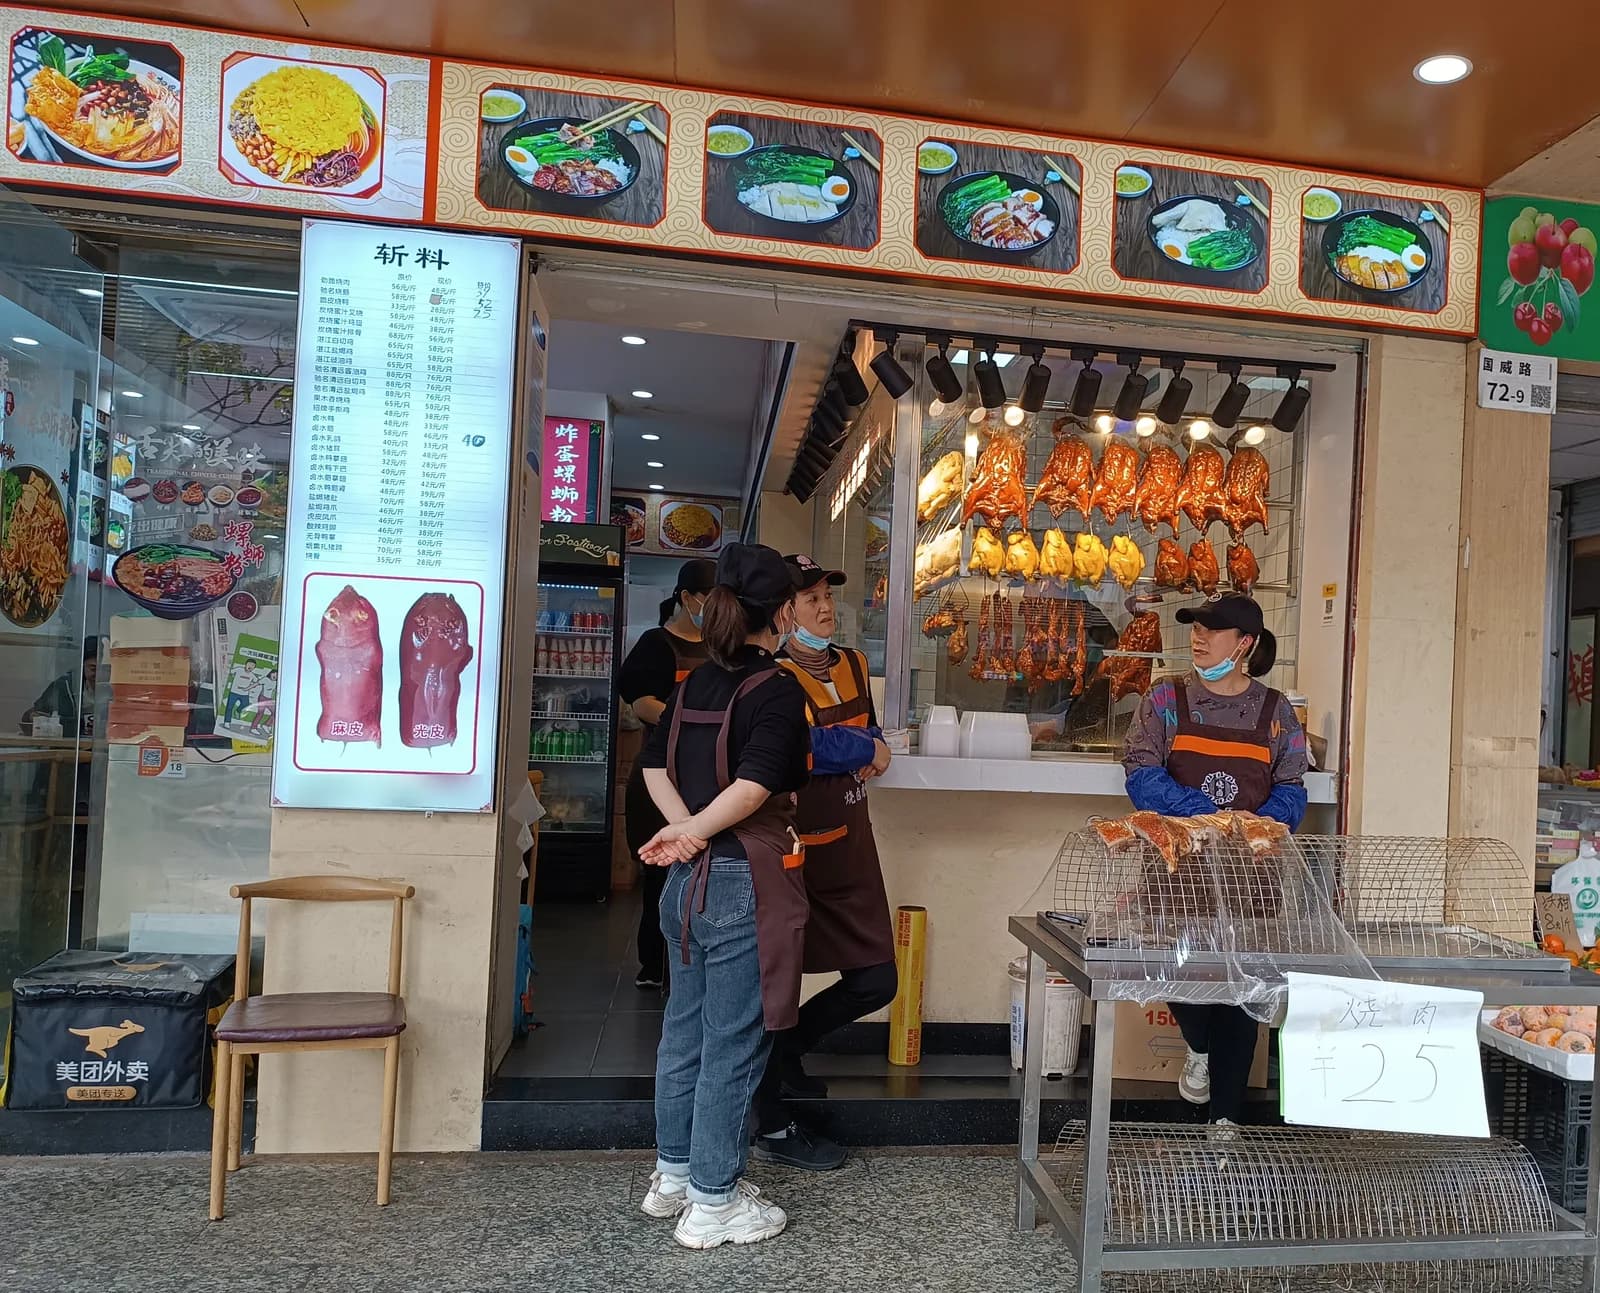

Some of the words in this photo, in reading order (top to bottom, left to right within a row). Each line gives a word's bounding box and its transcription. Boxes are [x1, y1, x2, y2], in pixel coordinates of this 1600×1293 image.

[374, 243, 449, 270] 斩料
[320, 307, 363, 316] 炭烧蜜汁叉烧
[318, 327, 362, 336] 炭烧蜜汁排骨
[317, 336, 353, 345] 湛江白切鸡
[388, 342, 413, 350] 65元/只
[316, 346, 353, 355] 湛江盐焗鸡
[388, 352, 412, 360] 65元/只
[387, 362, 412, 370] 65元/只
[1483, 358, 1531, 376] 国威路
[315, 375, 366, 385] 驰名清远白切鸡
[426, 384, 451, 392] 76元/只
[427, 374, 452, 382] 76元/只
[1487, 382, 1524, 403] 72-9
[385, 400, 410, 408] 65元/只
[313, 405, 349, 414] 招牌手撕鸡
[425, 413, 450, 421] 38元/斤
[312, 434, 341, 442] 卤水乳鸽
[138, 427, 266, 473] 舌尖的美味
[310, 464, 346, 472] 卤水鸭下巴
[421, 481, 446, 489] 42元/斤
[378, 517, 404, 525] 46元/斤
[221, 520, 266, 577] 螺蛳粉
[417, 549, 442, 557] 58元/斤
[332, 721, 363, 736] 麻皮
[413, 724, 444, 739] 光皮
[170, 763, 182, 772] 18
[1340, 997, 1437, 1034] 烧肉
[56, 1060, 149, 1083] 美团外卖
[77, 1089, 127, 1099] 美团专送
